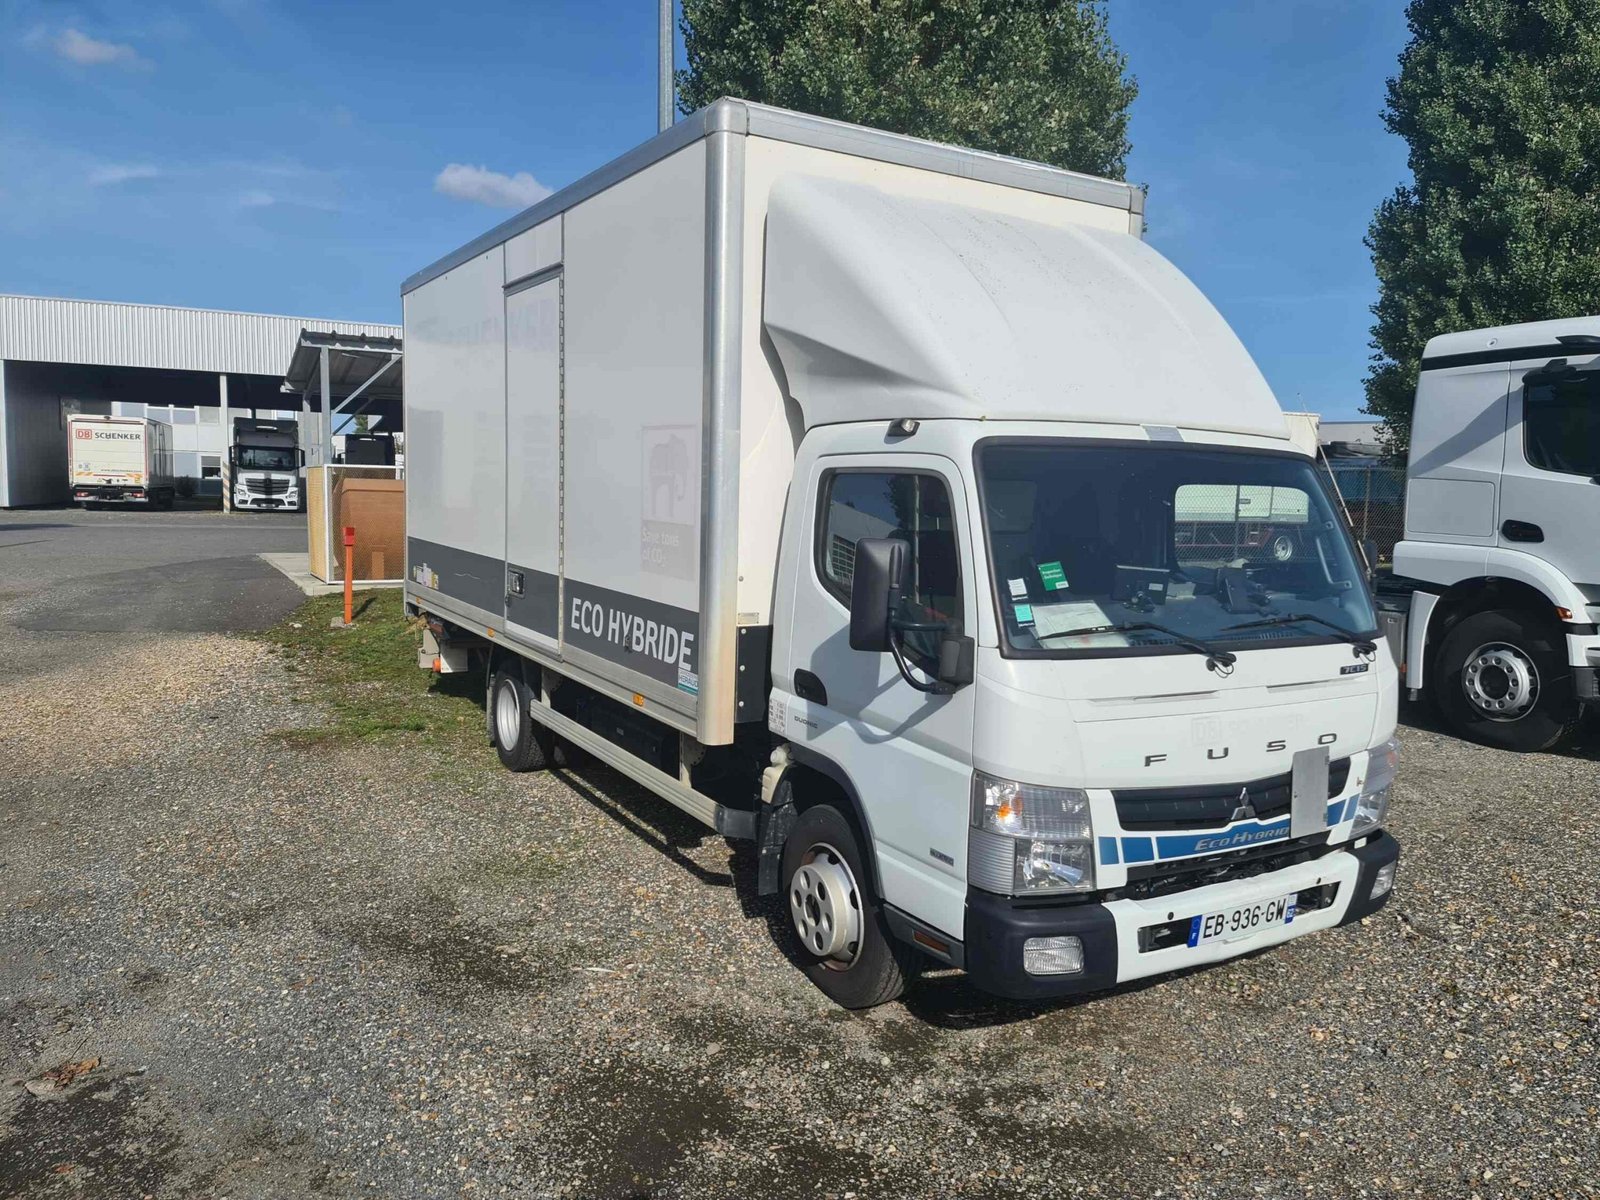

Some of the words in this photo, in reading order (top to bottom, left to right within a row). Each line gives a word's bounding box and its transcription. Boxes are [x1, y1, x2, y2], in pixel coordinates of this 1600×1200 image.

[77, 430, 90, 438] DB
[95, 432, 141, 440] SCHENKER
[570, 597, 604, 638] ECO
[608, 608, 694, 671] HYBRIDE
[1144, 733, 1337, 767] FUSO
[1202, 897, 1287, 939] EB-936-GW
